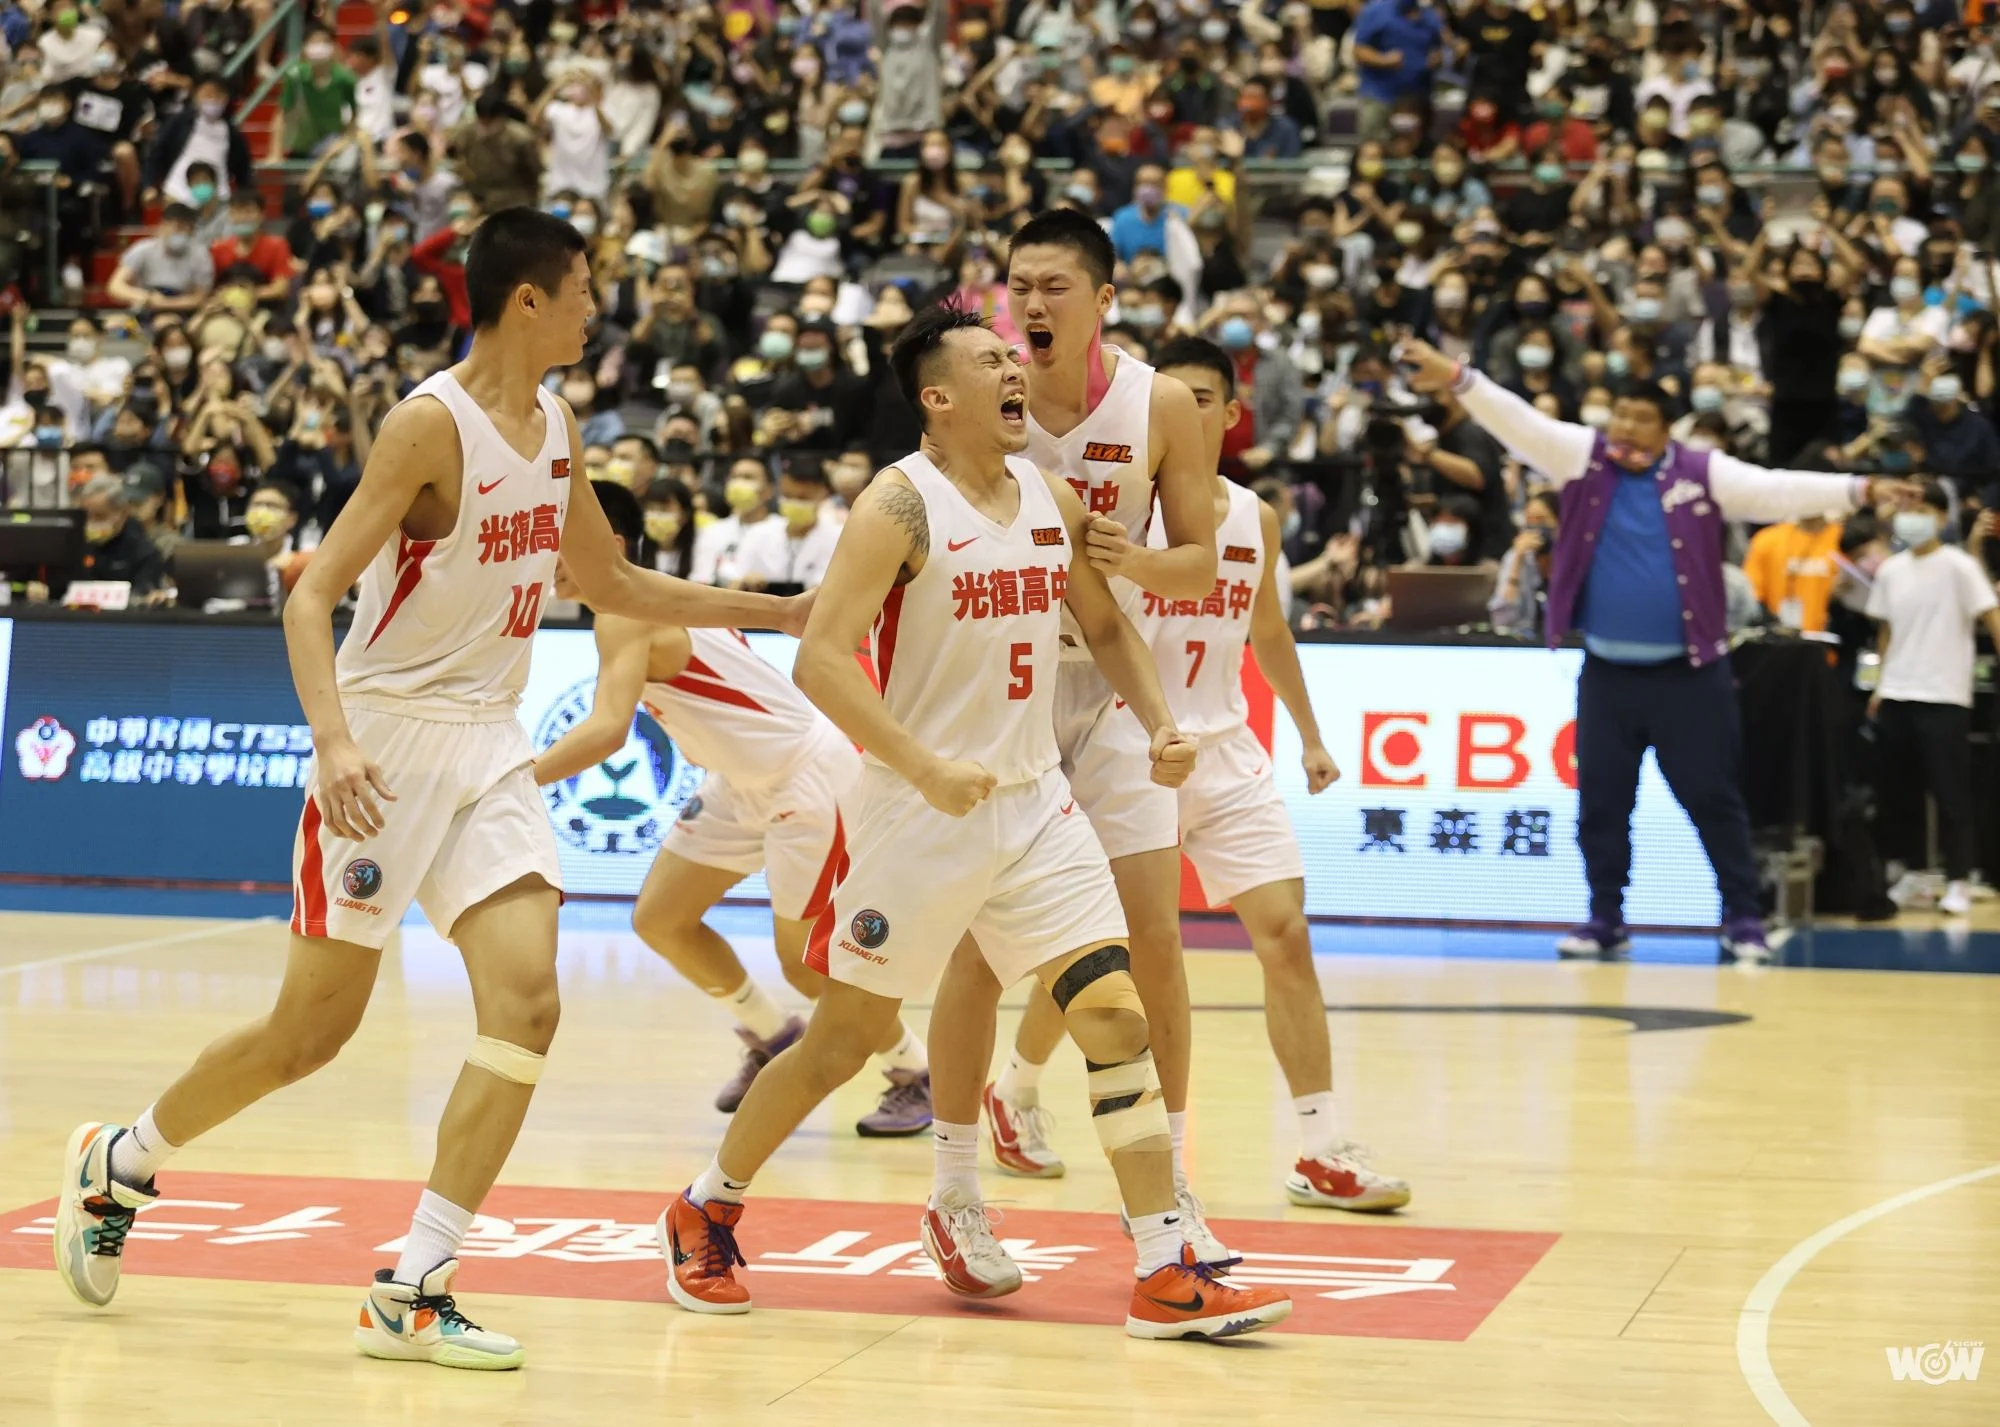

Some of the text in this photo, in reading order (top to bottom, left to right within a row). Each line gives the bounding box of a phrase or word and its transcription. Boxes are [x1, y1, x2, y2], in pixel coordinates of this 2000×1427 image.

[1065, 477, 1120, 516] 中
[478, 504, 564, 566] 光復高
[500, 582, 543, 639] 10
[952, 564, 1067, 621] 光復高中
[1008, 642, 1032, 700] 5
[1185, 640, 1206, 689] 7
[334, 897, 383, 916] KUANG FU
[837, 939, 889, 966] KUANG FU
